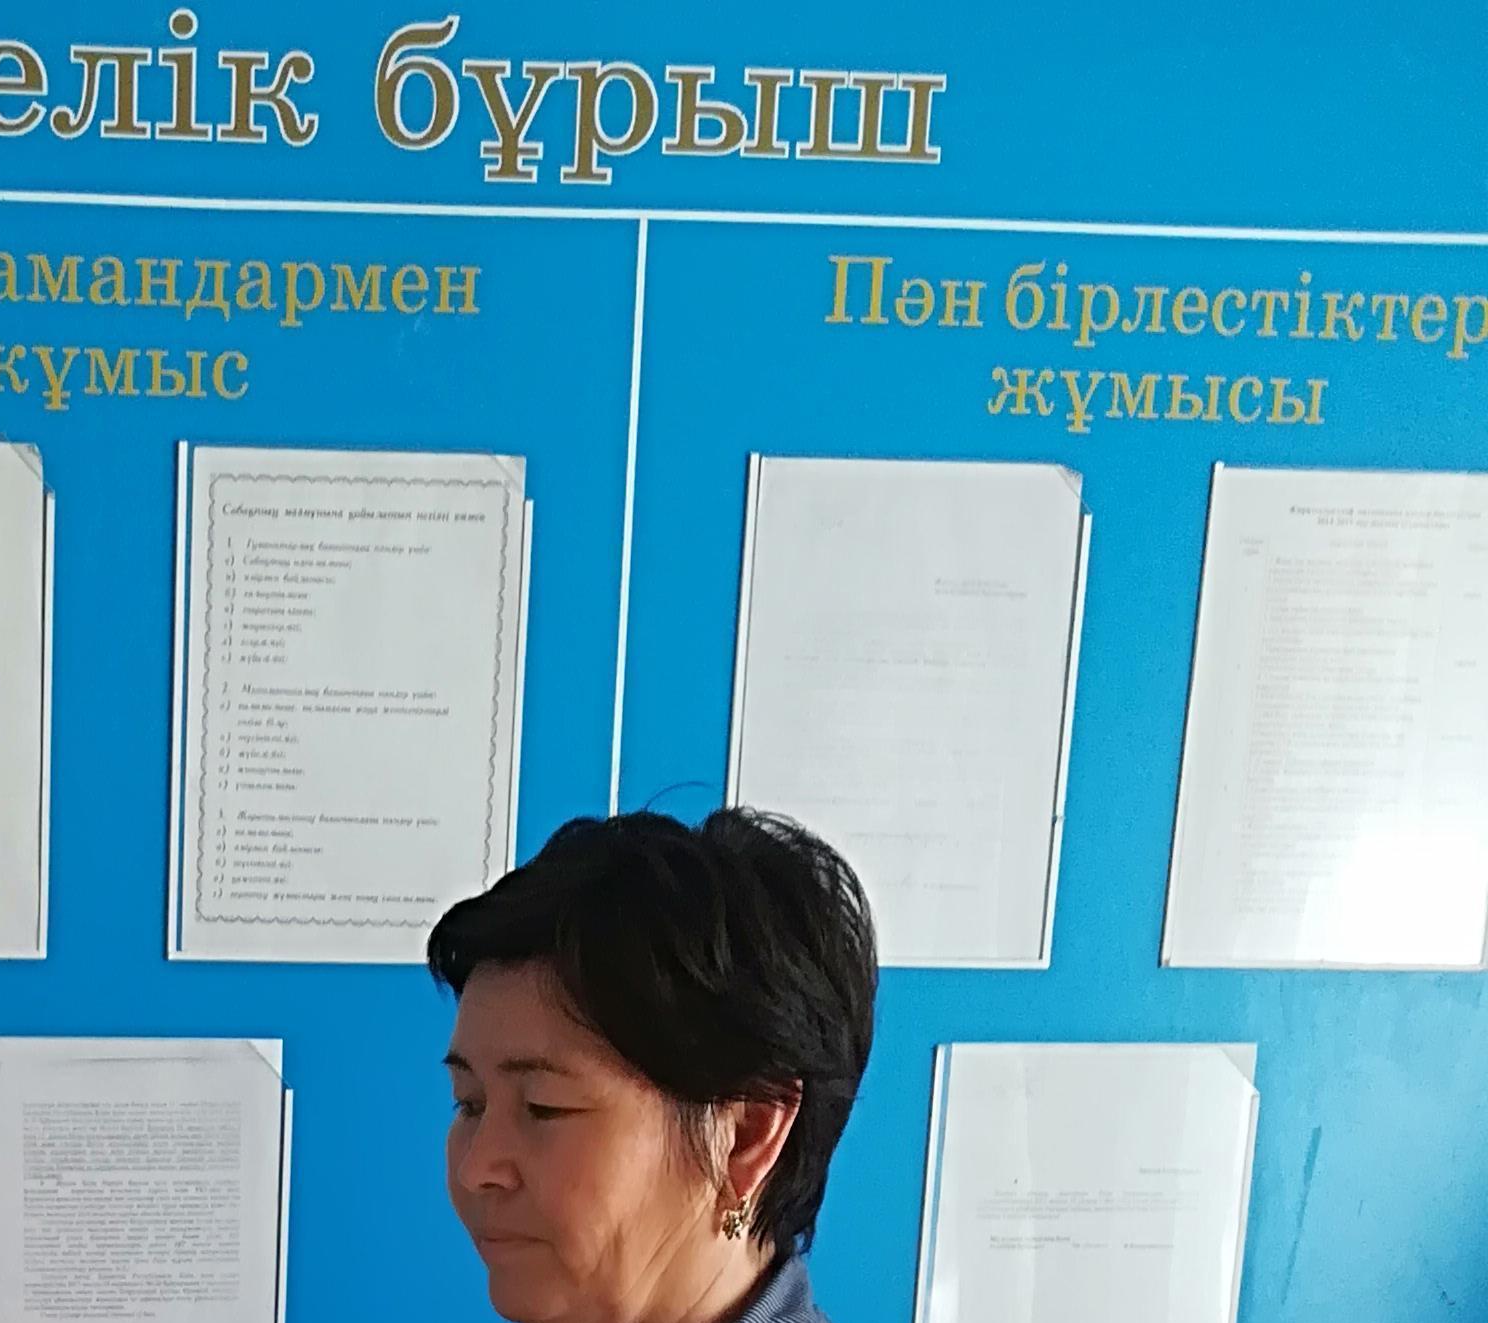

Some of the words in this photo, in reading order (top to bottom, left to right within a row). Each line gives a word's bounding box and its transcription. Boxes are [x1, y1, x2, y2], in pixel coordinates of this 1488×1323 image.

[375, 15, 948, 186] бұрыш
[825, 256, 986, 329] Пән
[1005, 263, 1488, 360] бірлестіктер
[988, 366, 1330, 434] жұмысы
